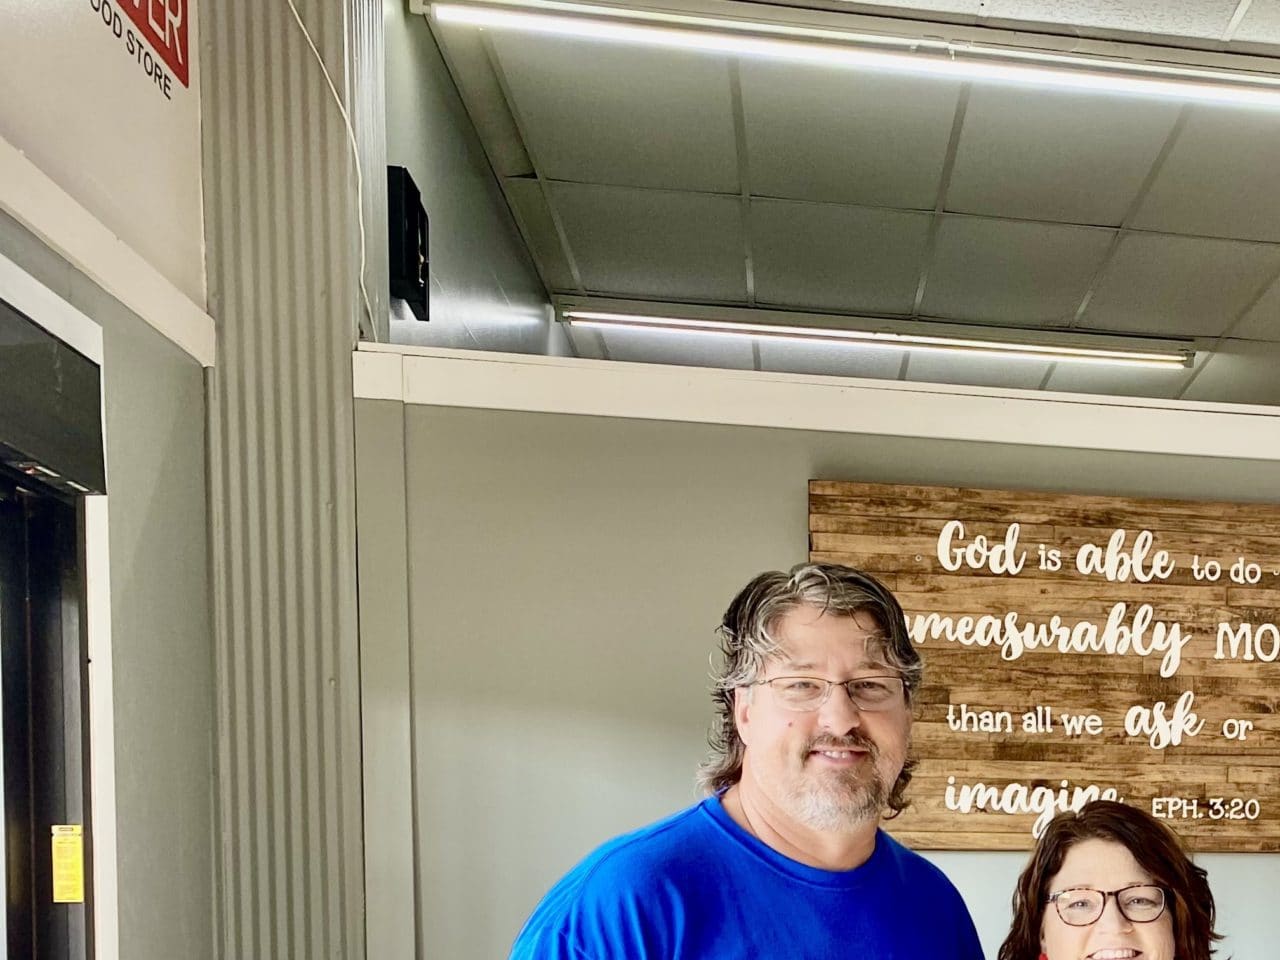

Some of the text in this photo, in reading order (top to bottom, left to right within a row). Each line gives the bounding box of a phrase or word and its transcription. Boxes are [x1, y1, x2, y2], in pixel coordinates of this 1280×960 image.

[126, 29, 172, 101] STORE
[938, 520, 1262, 584] God is able to do
[904, 603, 1193, 678] measurably
[946, 690, 1254, 750] than all we ask or
[1152, 797, 1204, 819] EPH.
[1208, 797, 1260, 820] 3:20
